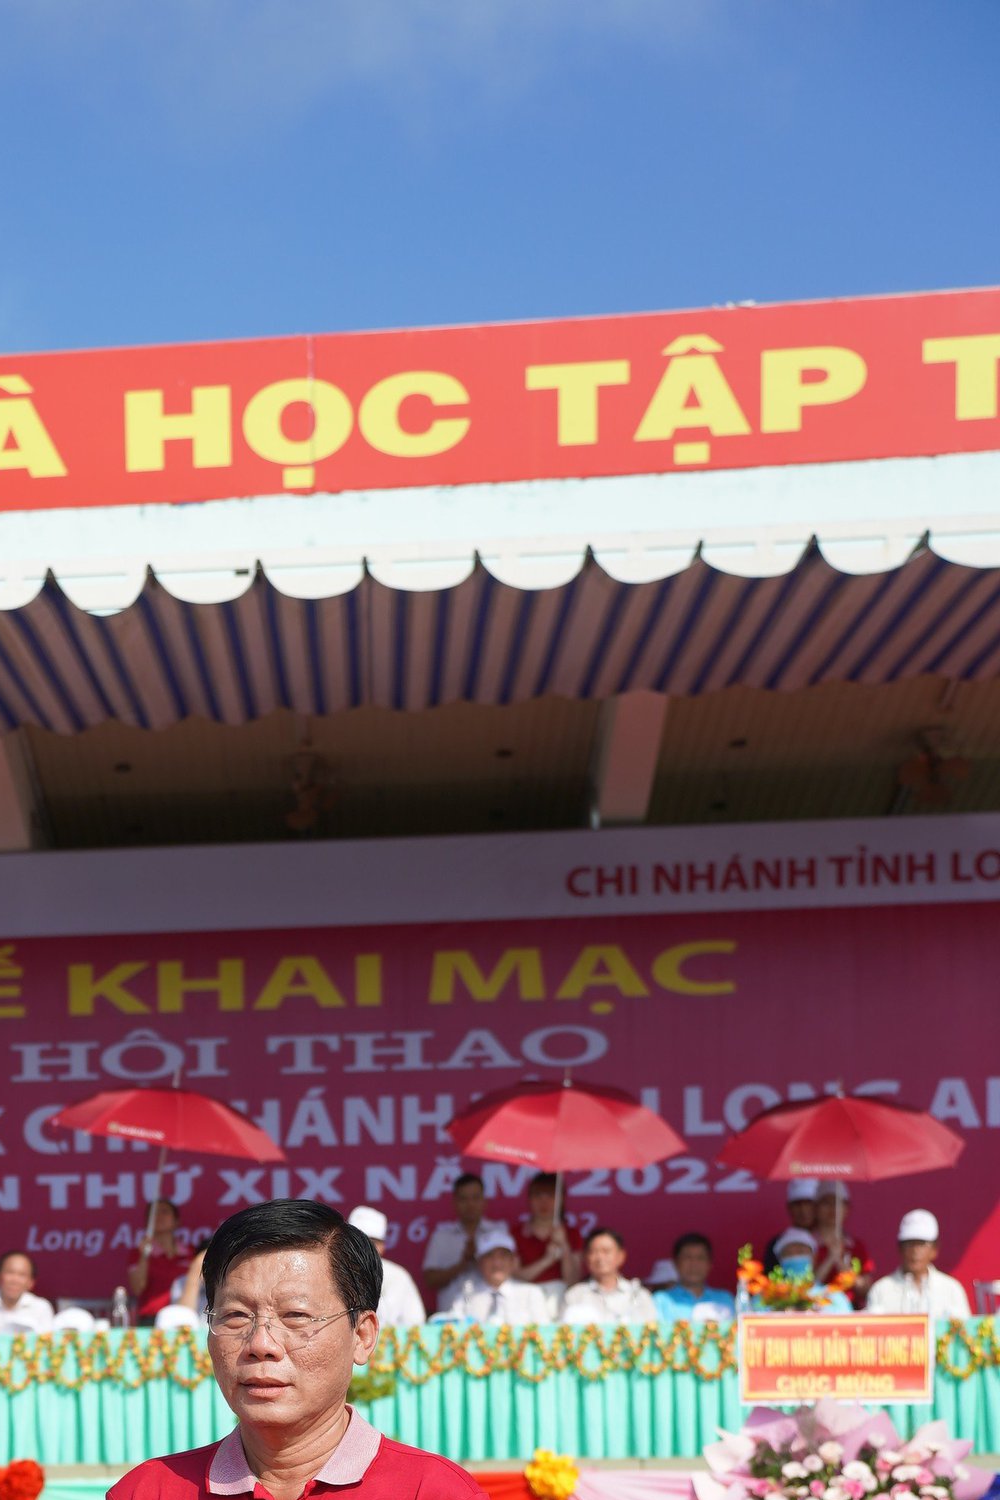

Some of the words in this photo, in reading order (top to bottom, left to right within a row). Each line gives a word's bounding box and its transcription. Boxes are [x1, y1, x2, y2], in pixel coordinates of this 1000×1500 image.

[124, 371, 471, 489] HỌC
[525, 334, 867, 465] TẬP
[565, 865, 639, 898] CHI
[652, 854, 817, 895] NHÁNH
[825, 845, 937, 888] TỈNH
[68, 954, 382, 1017] KHAI
[429, 940, 738, 1016] MẠC
[266, 1024, 610, 1075] THAO
[35, 1163, 203, 1210] THỨ
[218, 1167, 343, 1205] XIX
[26, 1224, 105, 1257] Long
